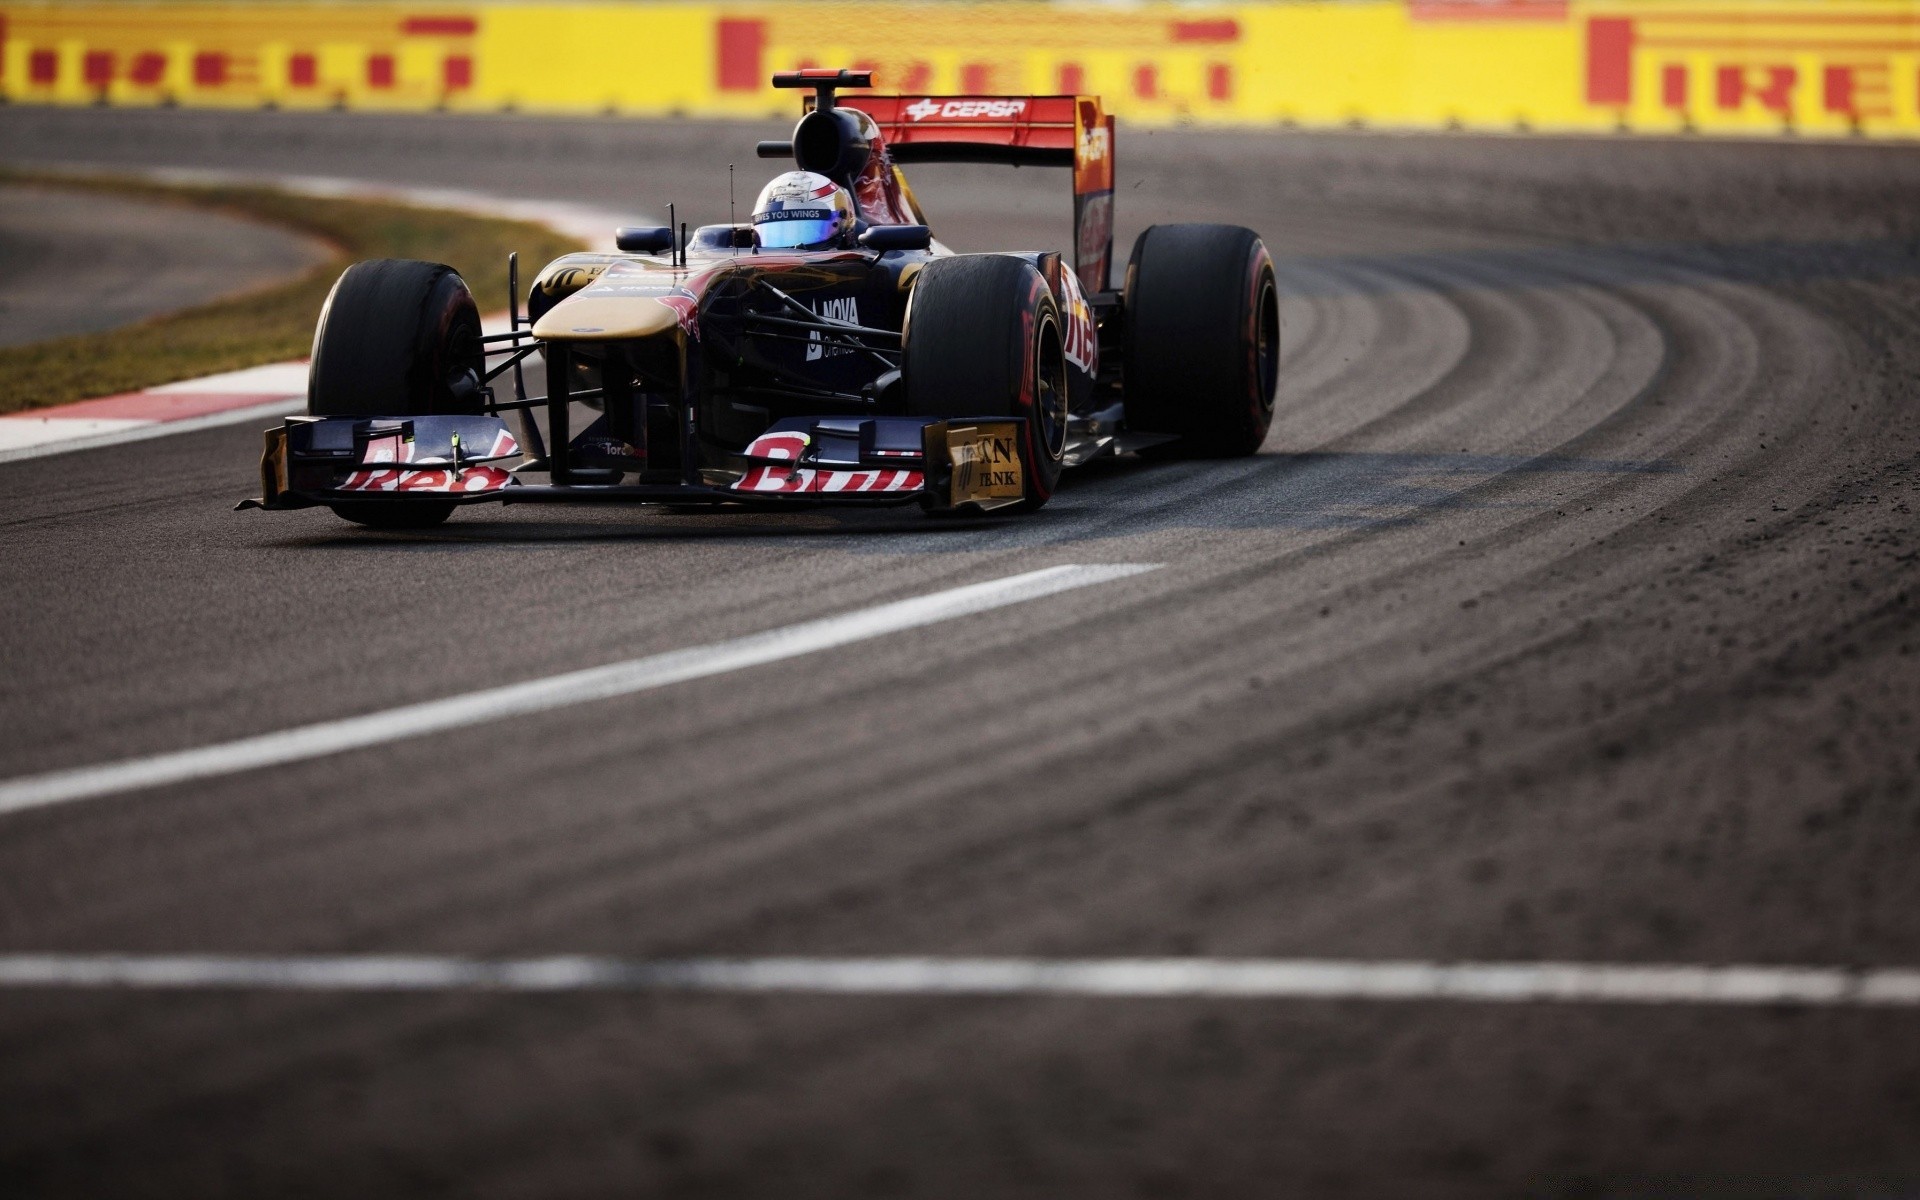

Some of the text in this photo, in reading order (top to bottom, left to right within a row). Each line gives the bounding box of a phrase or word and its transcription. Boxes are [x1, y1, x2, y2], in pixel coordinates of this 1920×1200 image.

[0, 16, 476, 90] IRELLI
[1586, 18, 1920, 116] PIRE
[771, 211, 789, 220] YOU
[791, 210, 820, 218] WINGS
[823, 297, 859, 326] NOVA
